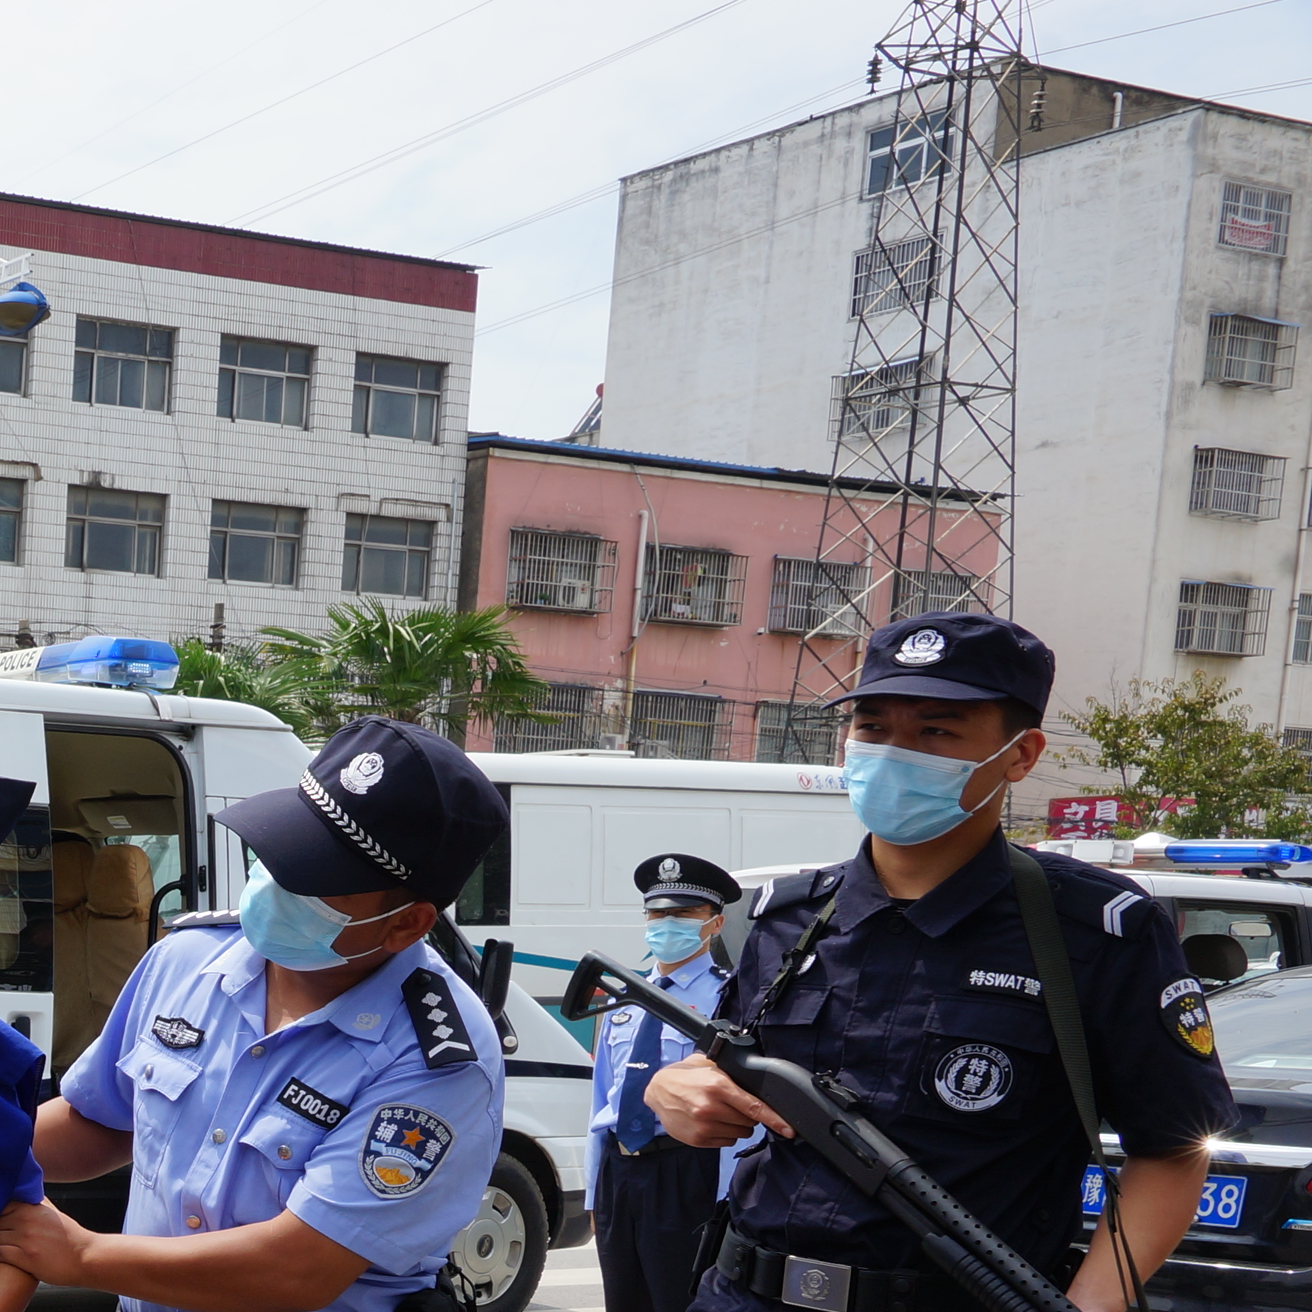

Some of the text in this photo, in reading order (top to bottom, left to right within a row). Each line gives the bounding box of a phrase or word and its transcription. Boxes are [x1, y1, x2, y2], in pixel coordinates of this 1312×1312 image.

[969, 969, 1042, 996] 特SWAT警
[1165, 980, 1195, 1000] SWAT
[962, 1057, 989, 1094] 特警
[283, 1084, 341, 1124] FJ0018
[948, 1095, 978, 1109] SWAT
[380, 1108, 451, 1145] 中华人民共和国
[385, 1147, 418, 1166] FUJING
